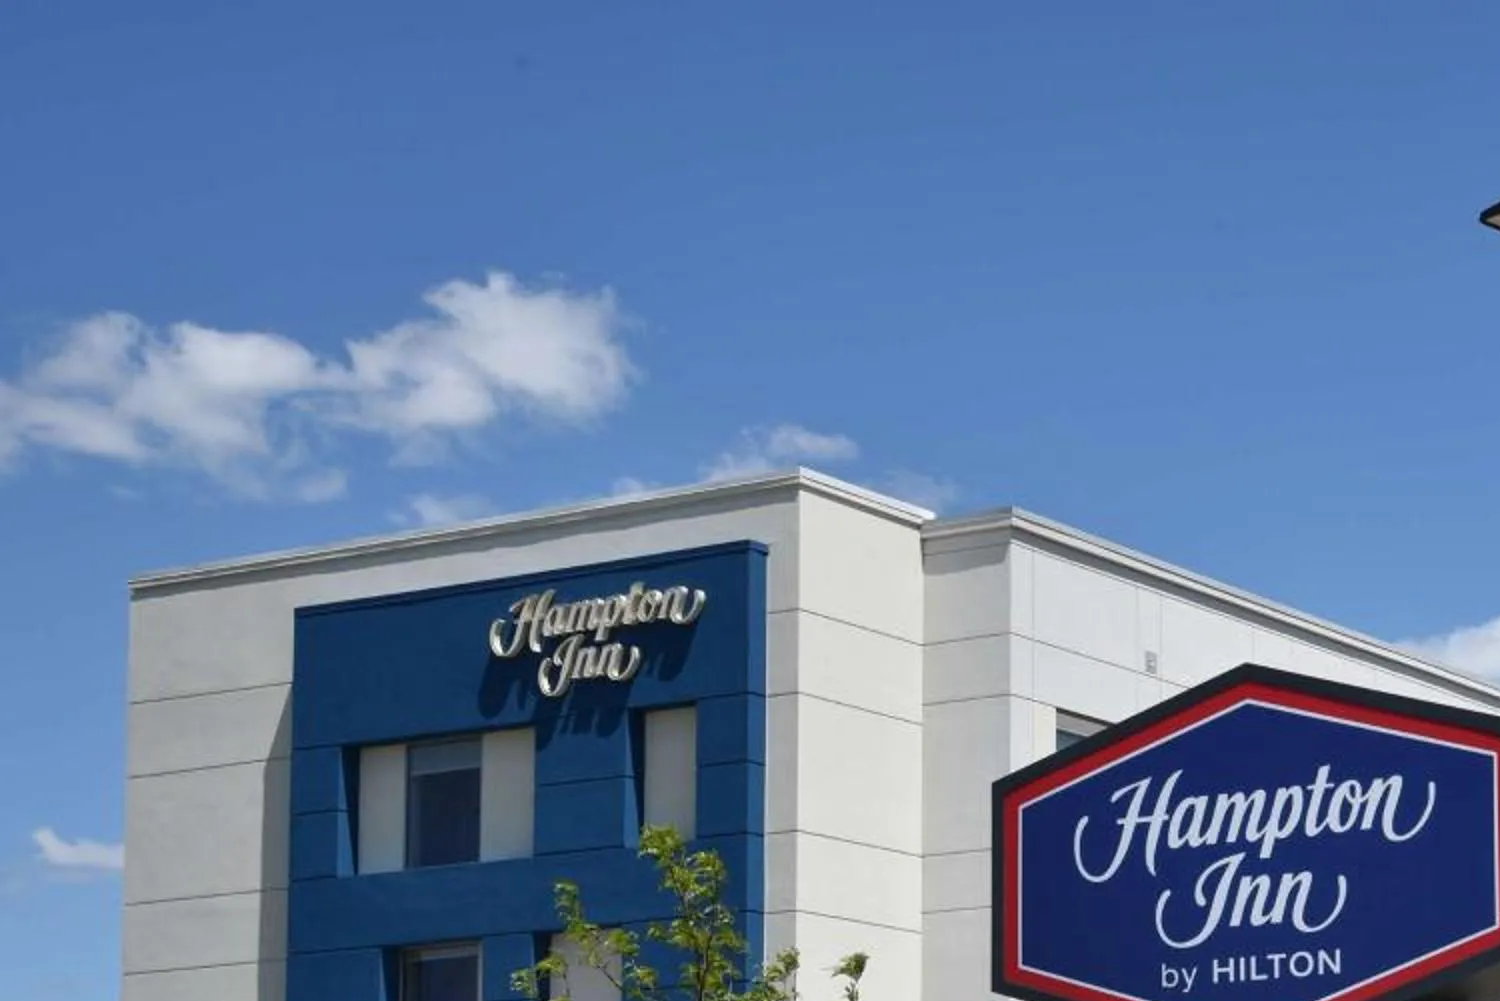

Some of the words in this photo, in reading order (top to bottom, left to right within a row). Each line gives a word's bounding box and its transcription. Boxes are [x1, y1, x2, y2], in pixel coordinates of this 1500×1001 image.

[489, 582, 707, 657] Hampton
[538, 633, 641, 697] Inn
[1073, 764, 1436, 883] Hampton
[1154, 852, 1347, 949] Inn
[1160, 963, 1198, 993] by
[1212, 948, 1342, 984] HILTON
